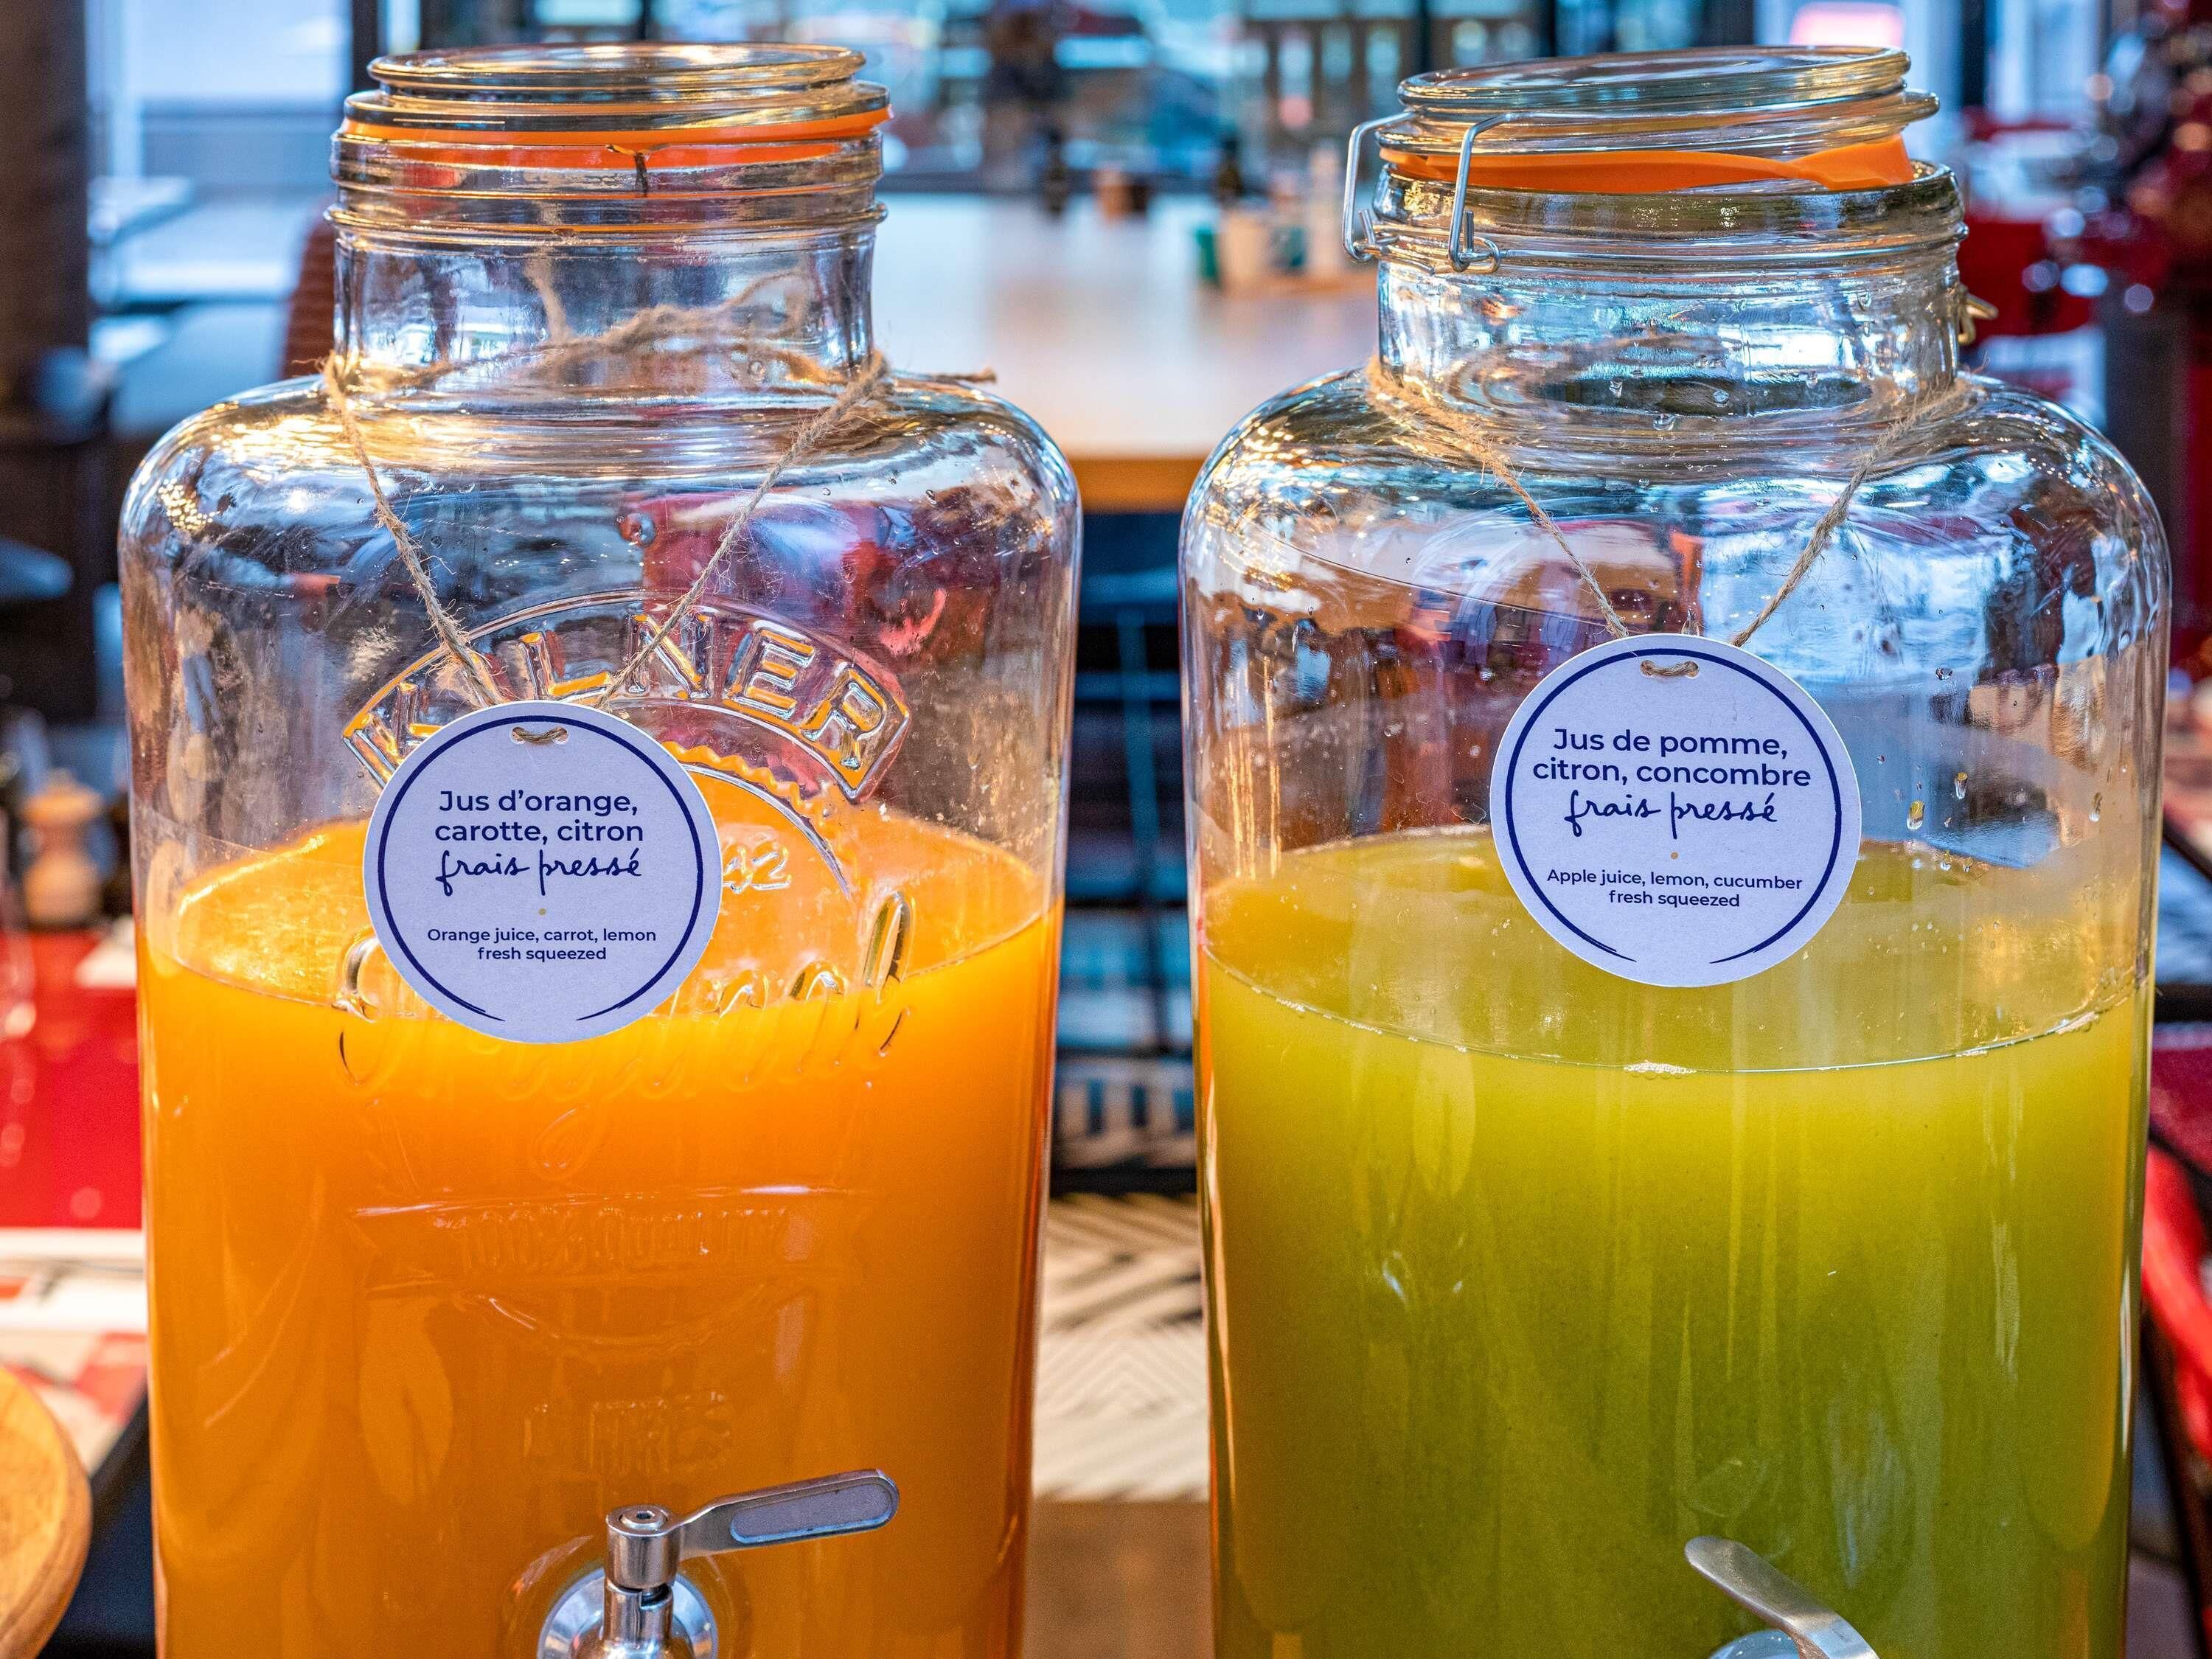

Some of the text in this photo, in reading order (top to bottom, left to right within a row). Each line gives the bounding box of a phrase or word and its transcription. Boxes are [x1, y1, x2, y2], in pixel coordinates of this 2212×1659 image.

[1553, 728, 1788, 760] Jus de pomme,
[1532, 756, 1812, 787] citron, concombre
[438, 790, 490, 812] Jus
[1563, 789, 1778, 840] frais pressé
[434, 818, 644, 846] carotte, citron
[434, 847, 642, 897] frais pressé
[1546, 869, 1803, 890] Apple juice, lemon, cucumber
[1608, 889, 1740, 908] fresh squeezed
[427, 928, 656, 944] Orange juice, carrot, lemon
[477, 946, 607, 963] fresh squeezed
